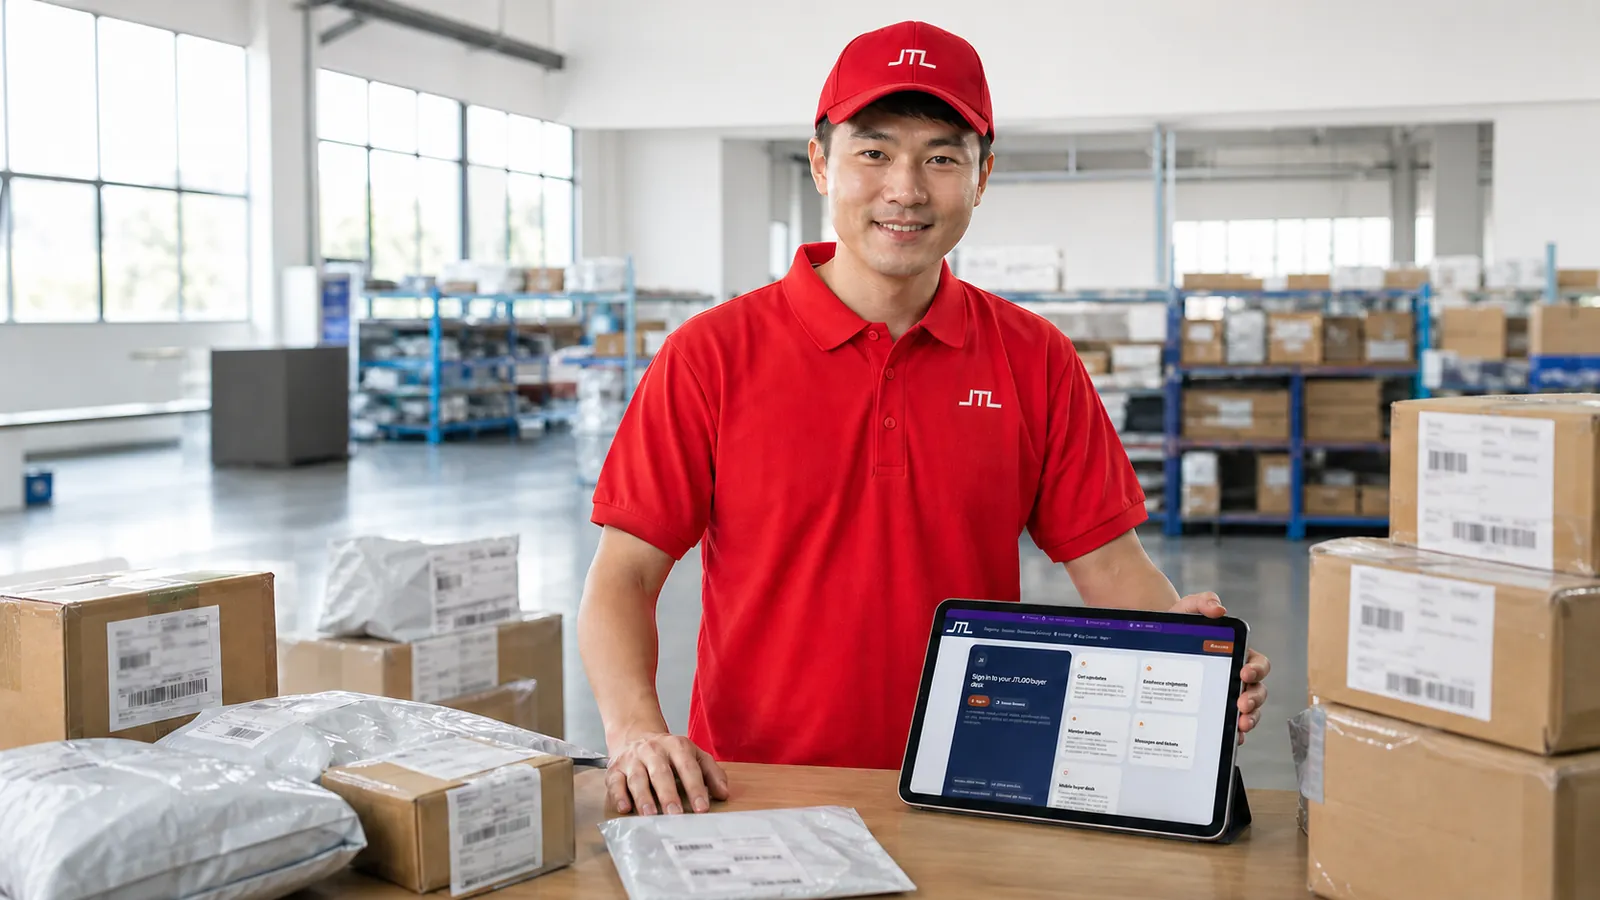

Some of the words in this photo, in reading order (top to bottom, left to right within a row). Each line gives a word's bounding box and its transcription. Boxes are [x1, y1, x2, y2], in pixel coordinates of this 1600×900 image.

[888, 49, 937, 69] JTL
[958, 389, 1002, 408] JTL
[946, 621, 973, 634] JTL
[972, 673, 985, 682] Sign
[1030, 678, 1047, 686] buyer
